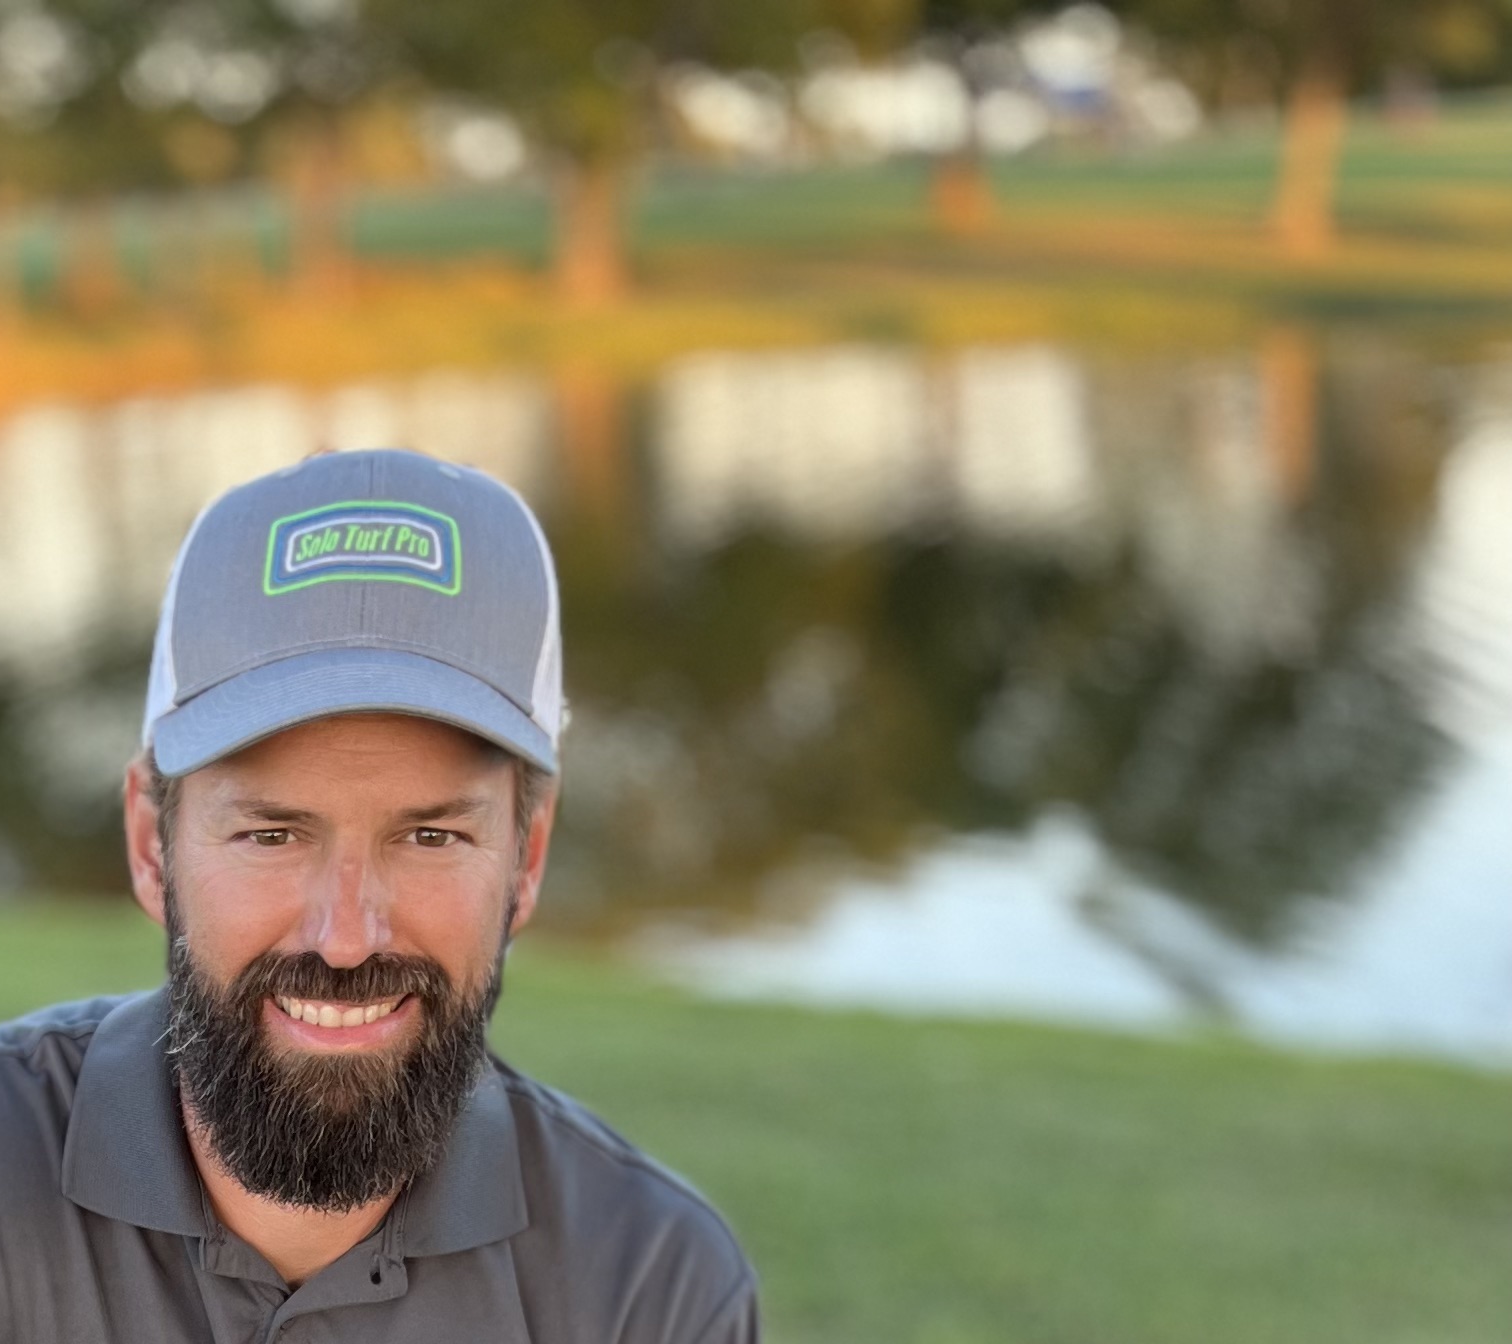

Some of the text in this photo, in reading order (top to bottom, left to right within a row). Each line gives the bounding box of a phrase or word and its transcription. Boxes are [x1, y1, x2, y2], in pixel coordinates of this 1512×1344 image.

[295, 524, 430, 562] Solo Turf Pro
